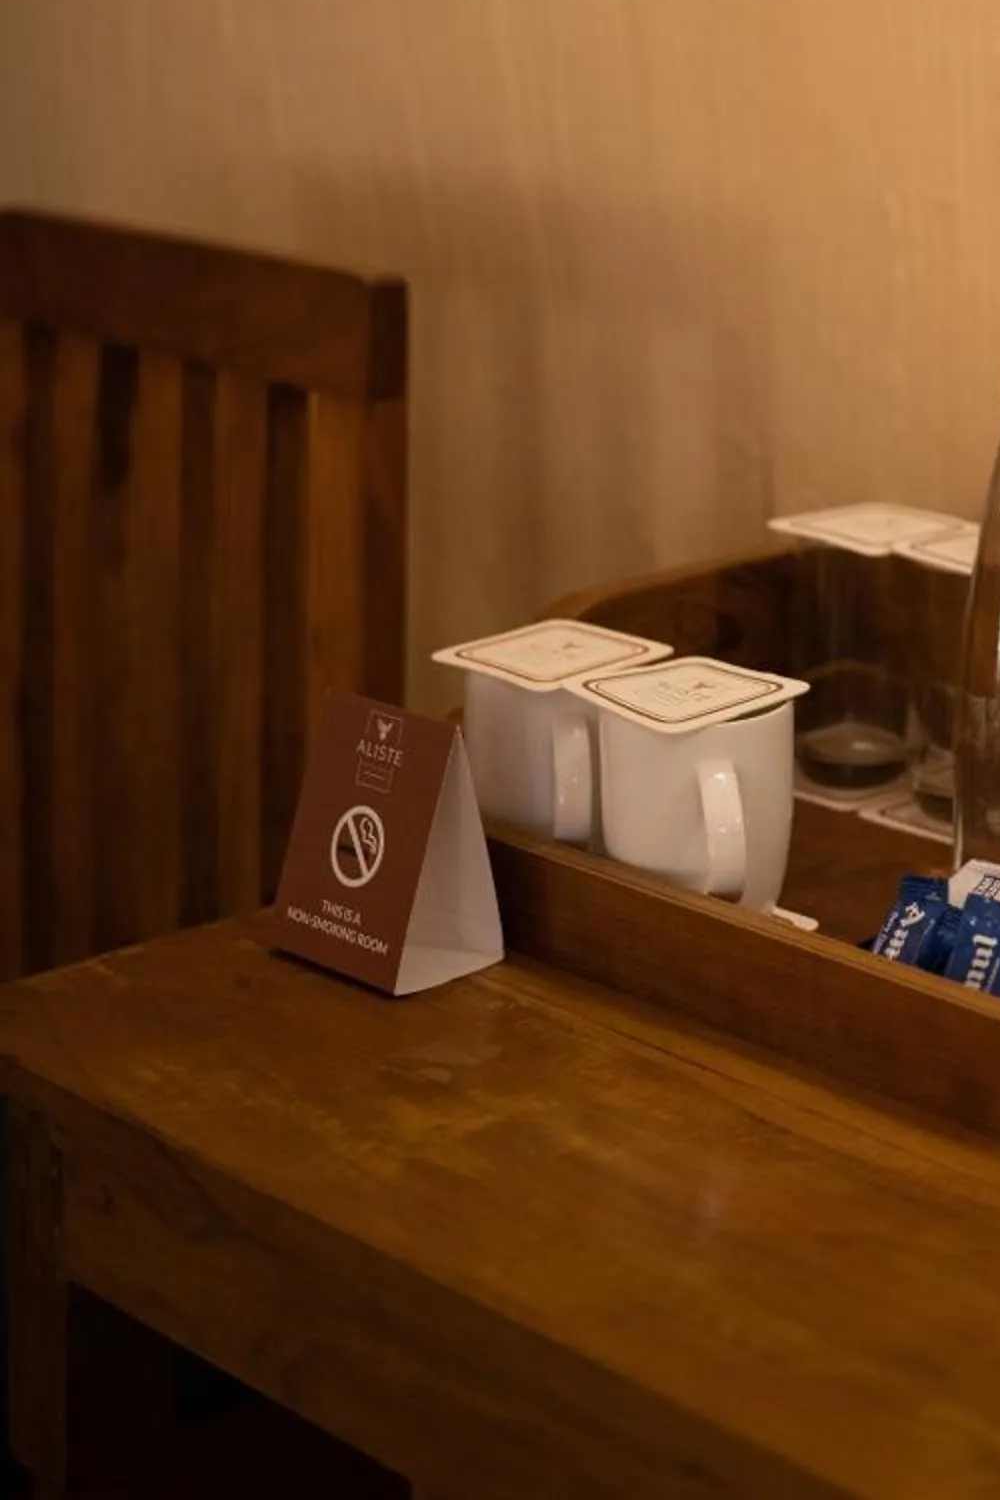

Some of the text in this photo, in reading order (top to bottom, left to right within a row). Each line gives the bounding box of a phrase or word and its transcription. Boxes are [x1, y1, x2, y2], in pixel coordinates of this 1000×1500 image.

[356, 739, 404, 767] ALISTE
[321, 899, 343, 919] THIS
[287, 906, 388, 956] NON-SMOKING ROOM
